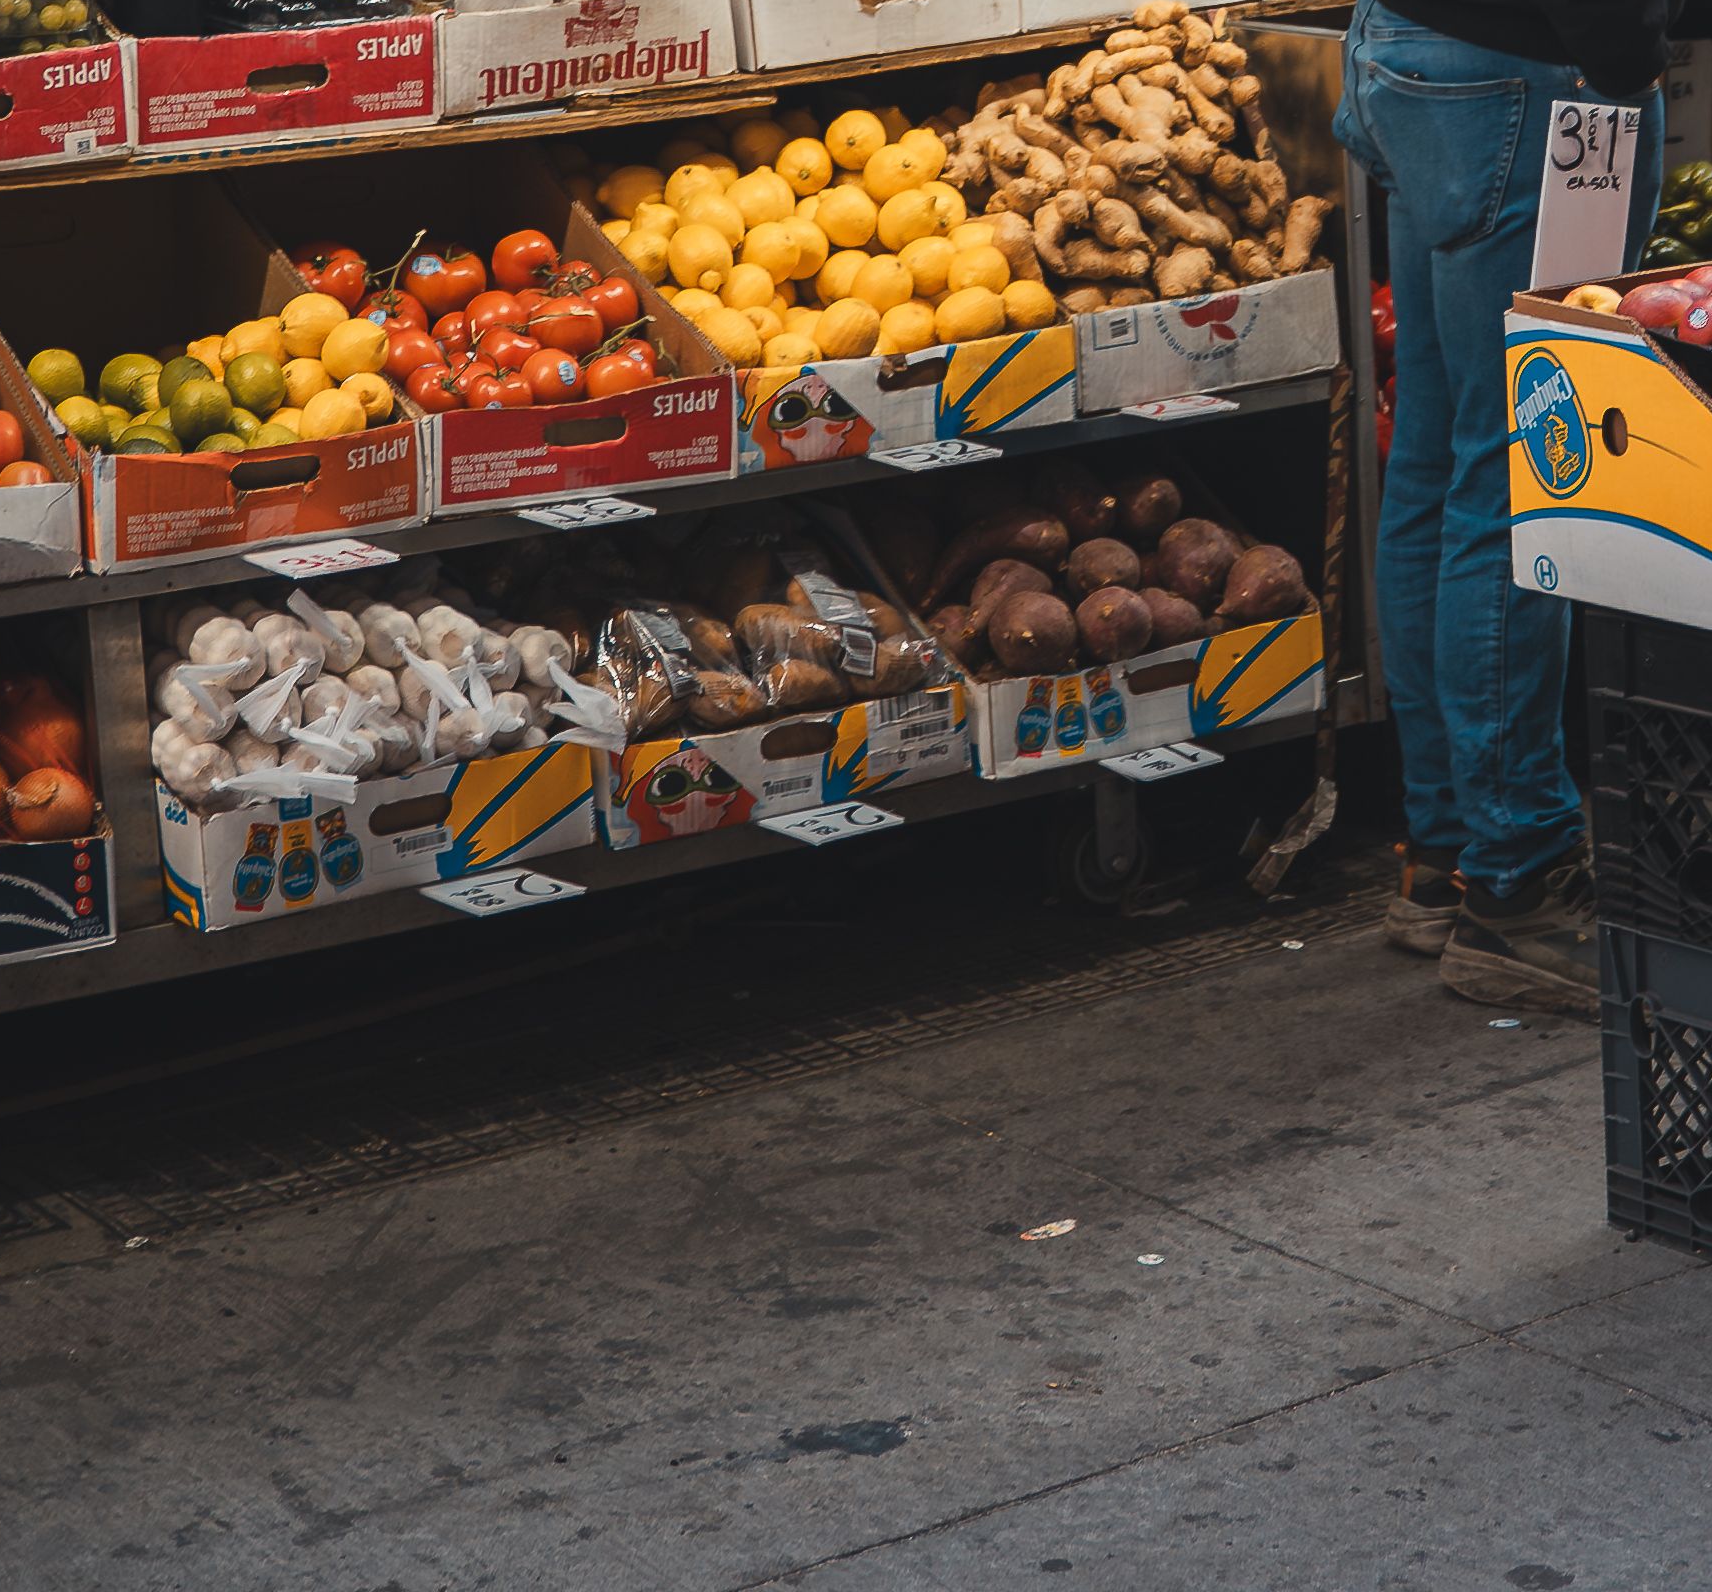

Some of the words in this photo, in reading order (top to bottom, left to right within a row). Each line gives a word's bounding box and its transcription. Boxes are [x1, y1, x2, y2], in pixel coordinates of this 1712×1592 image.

[357, 33, 423, 60] APPLES
[43, 58, 112, 89] APPLES
[476, 29, 710, 107] Independent
[1550, 104, 1586, 171] 3
[1607, 106, 1619, 173] 1
[653, 388, 719, 417] APPLES
[1514, 368, 1574, 433] Chiquita
[347, 436, 409, 470] APPLES
